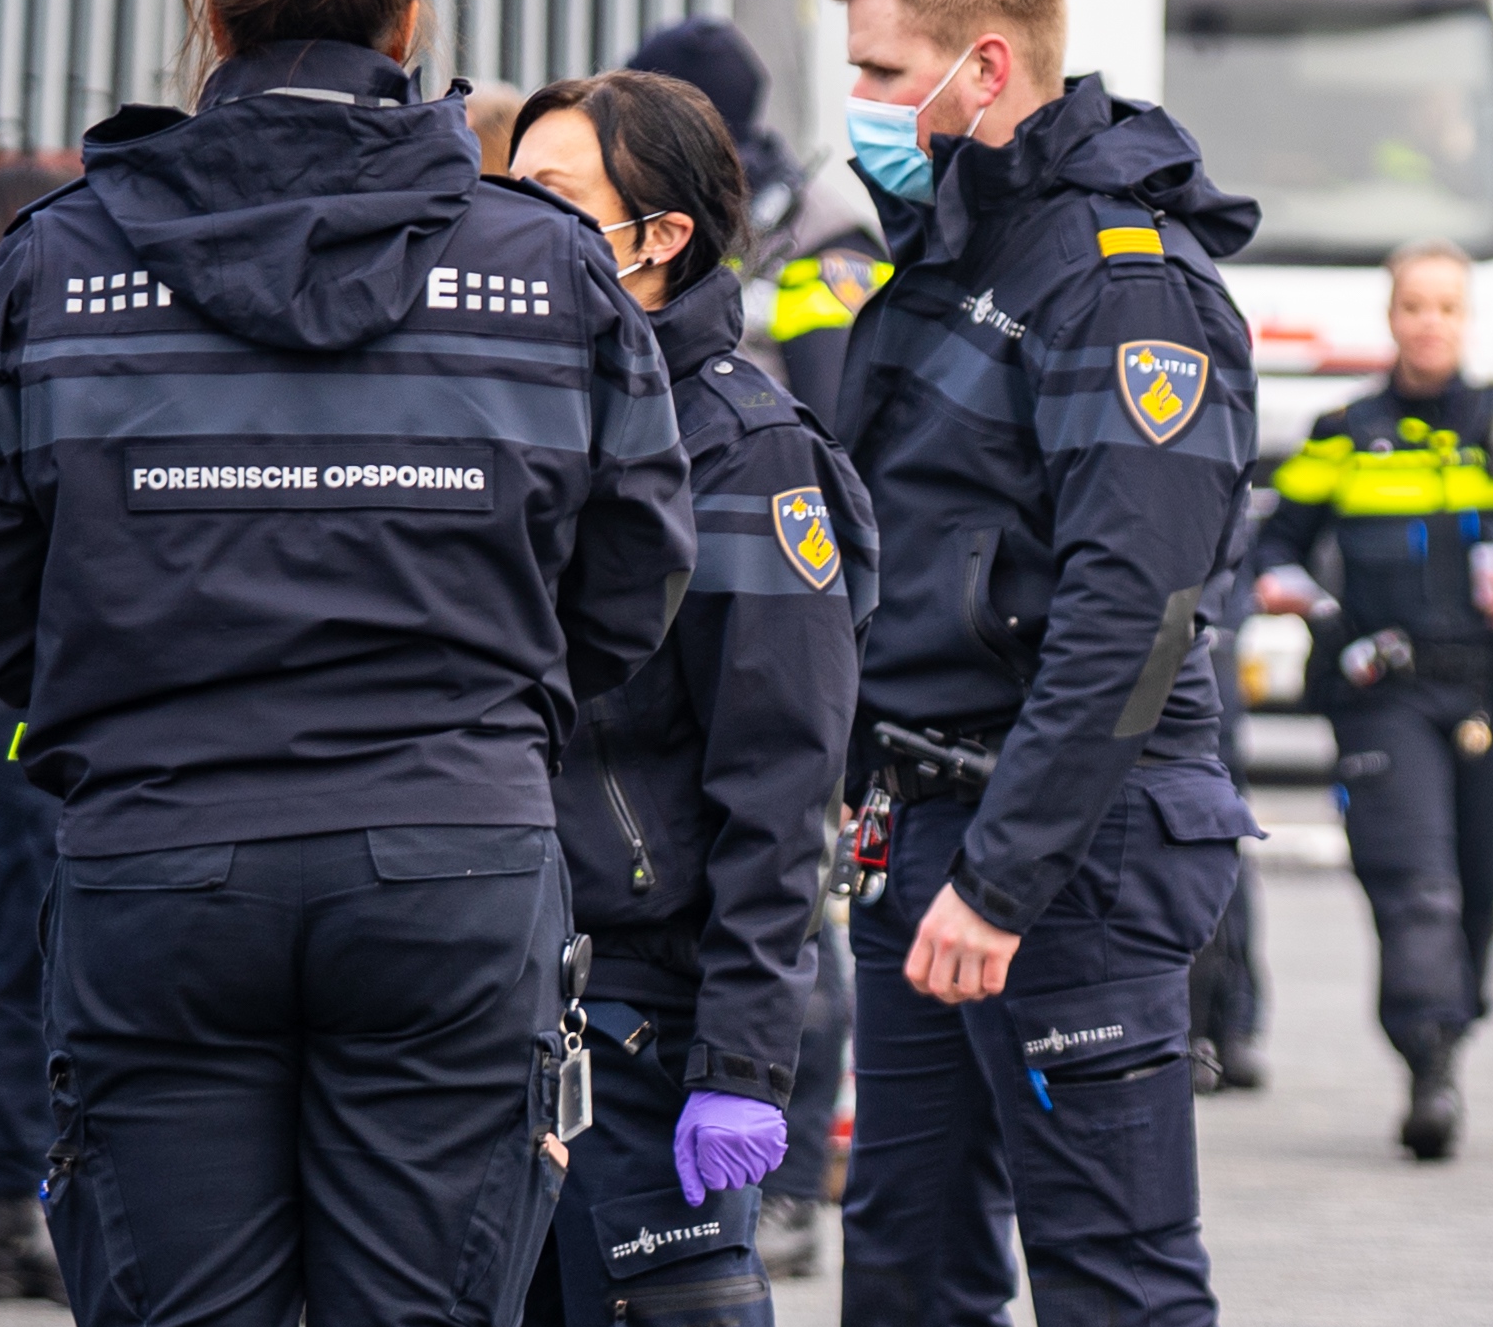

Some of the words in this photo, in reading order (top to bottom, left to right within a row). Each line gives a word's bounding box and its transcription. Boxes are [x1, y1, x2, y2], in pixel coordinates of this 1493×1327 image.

[1127, 353, 1198, 377] POLITIE
[132, 466, 318, 491] FORENSISCHE
[323, 465, 486, 491] OPSPORING
[782, 502, 829, 522] POLIT
